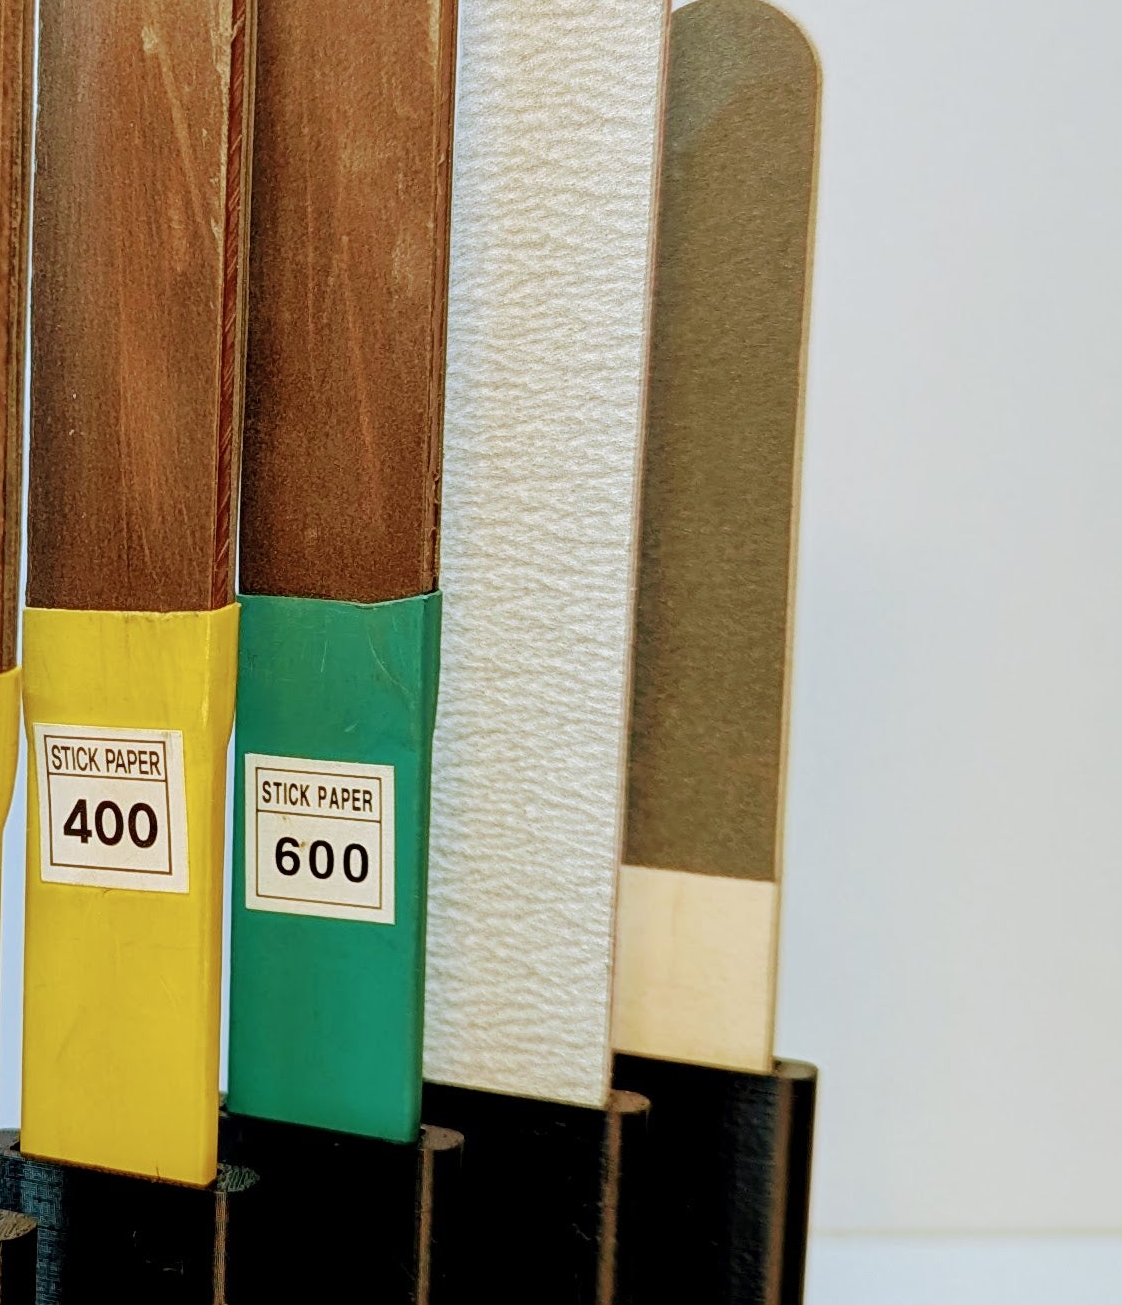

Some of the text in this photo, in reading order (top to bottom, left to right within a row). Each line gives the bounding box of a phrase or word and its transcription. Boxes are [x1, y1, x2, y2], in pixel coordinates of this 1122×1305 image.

[51, 744, 161, 776] STICK PAPER
[262, 780, 373, 813] STICK PAPER
[63, 798, 158, 849] 400
[275, 836, 369, 883] 600
